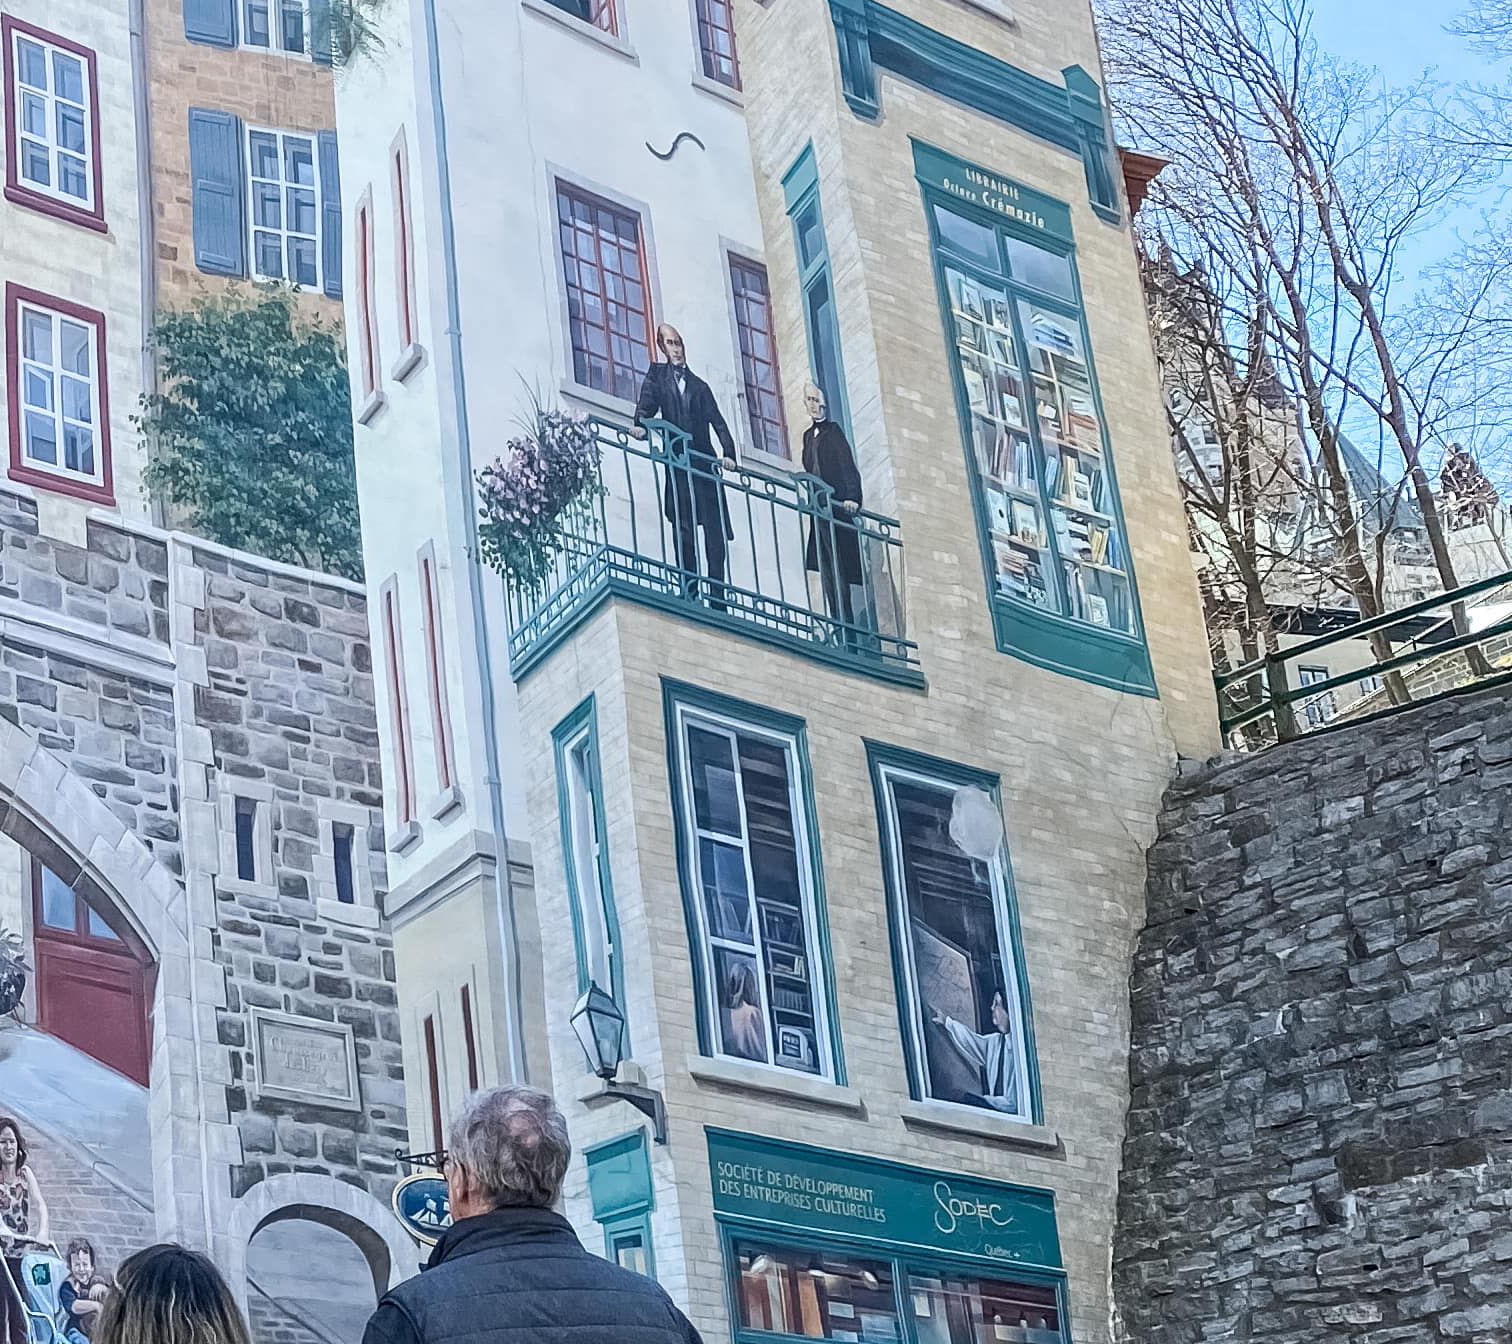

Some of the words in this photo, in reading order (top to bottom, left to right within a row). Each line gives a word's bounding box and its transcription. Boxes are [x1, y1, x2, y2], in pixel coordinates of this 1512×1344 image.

[965, 167, 1020, 201] LIBRAIRIE
[982, 191, 1045, 228] Crémazie
[717, 1160, 764, 1184] SOCIÉTÉ
[767, 1170, 782, 1187] DE
[786, 1173, 874, 1204] DÉVELOPPEMENT
[719, 1179, 741, 1197] DES
[743, 1183, 812, 1210] ENTREPRISES
[814, 1197, 887, 1223] CULTURELLES
